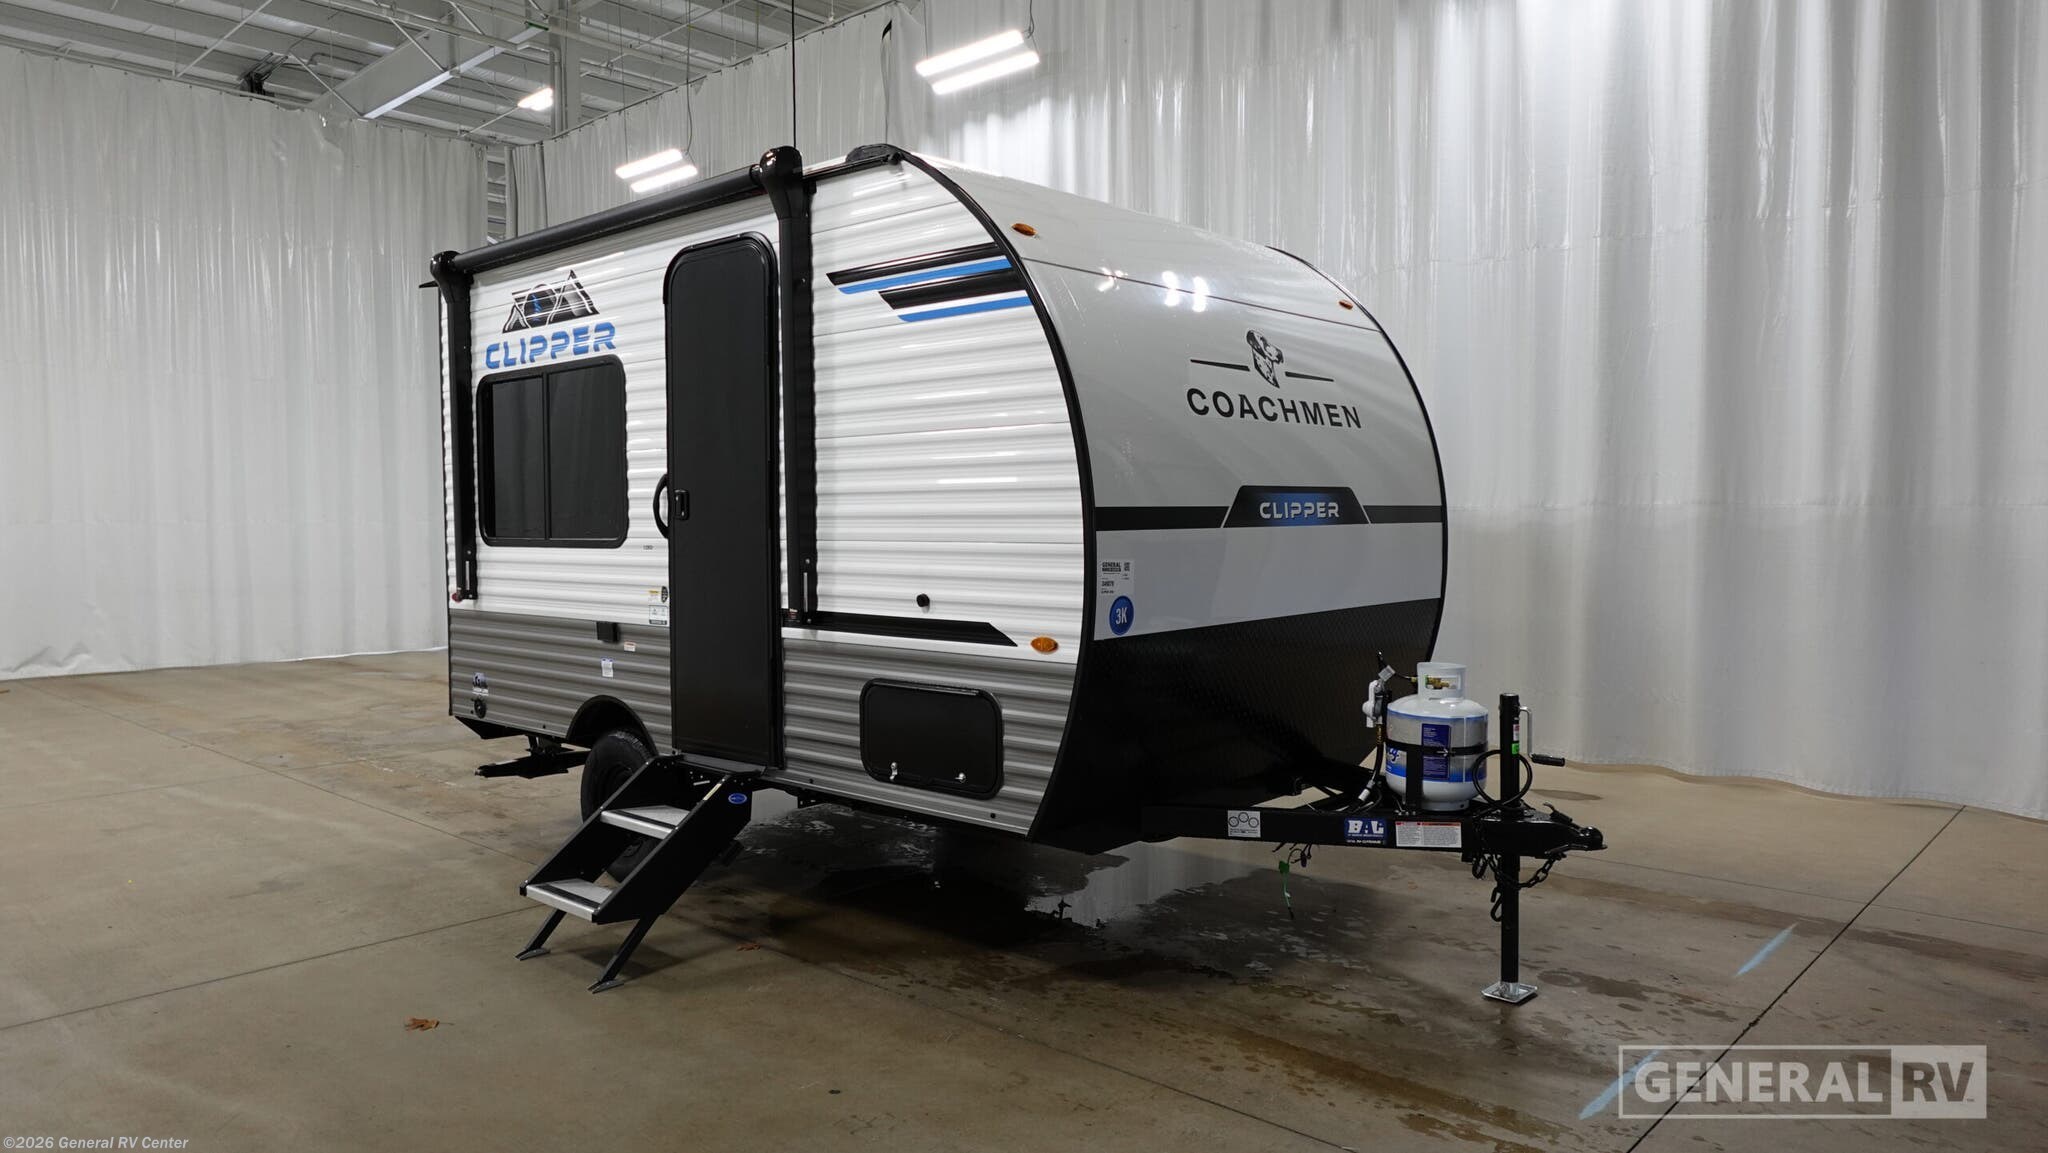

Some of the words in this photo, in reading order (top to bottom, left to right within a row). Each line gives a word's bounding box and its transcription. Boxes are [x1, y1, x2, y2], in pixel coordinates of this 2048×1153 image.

[485, 322, 616, 369] CLIPPER
[1187, 388, 1361, 429] COACHMEN
[1259, 502, 1339, 519] CLIPPER
[1115, 608, 1127, 625] 3K
